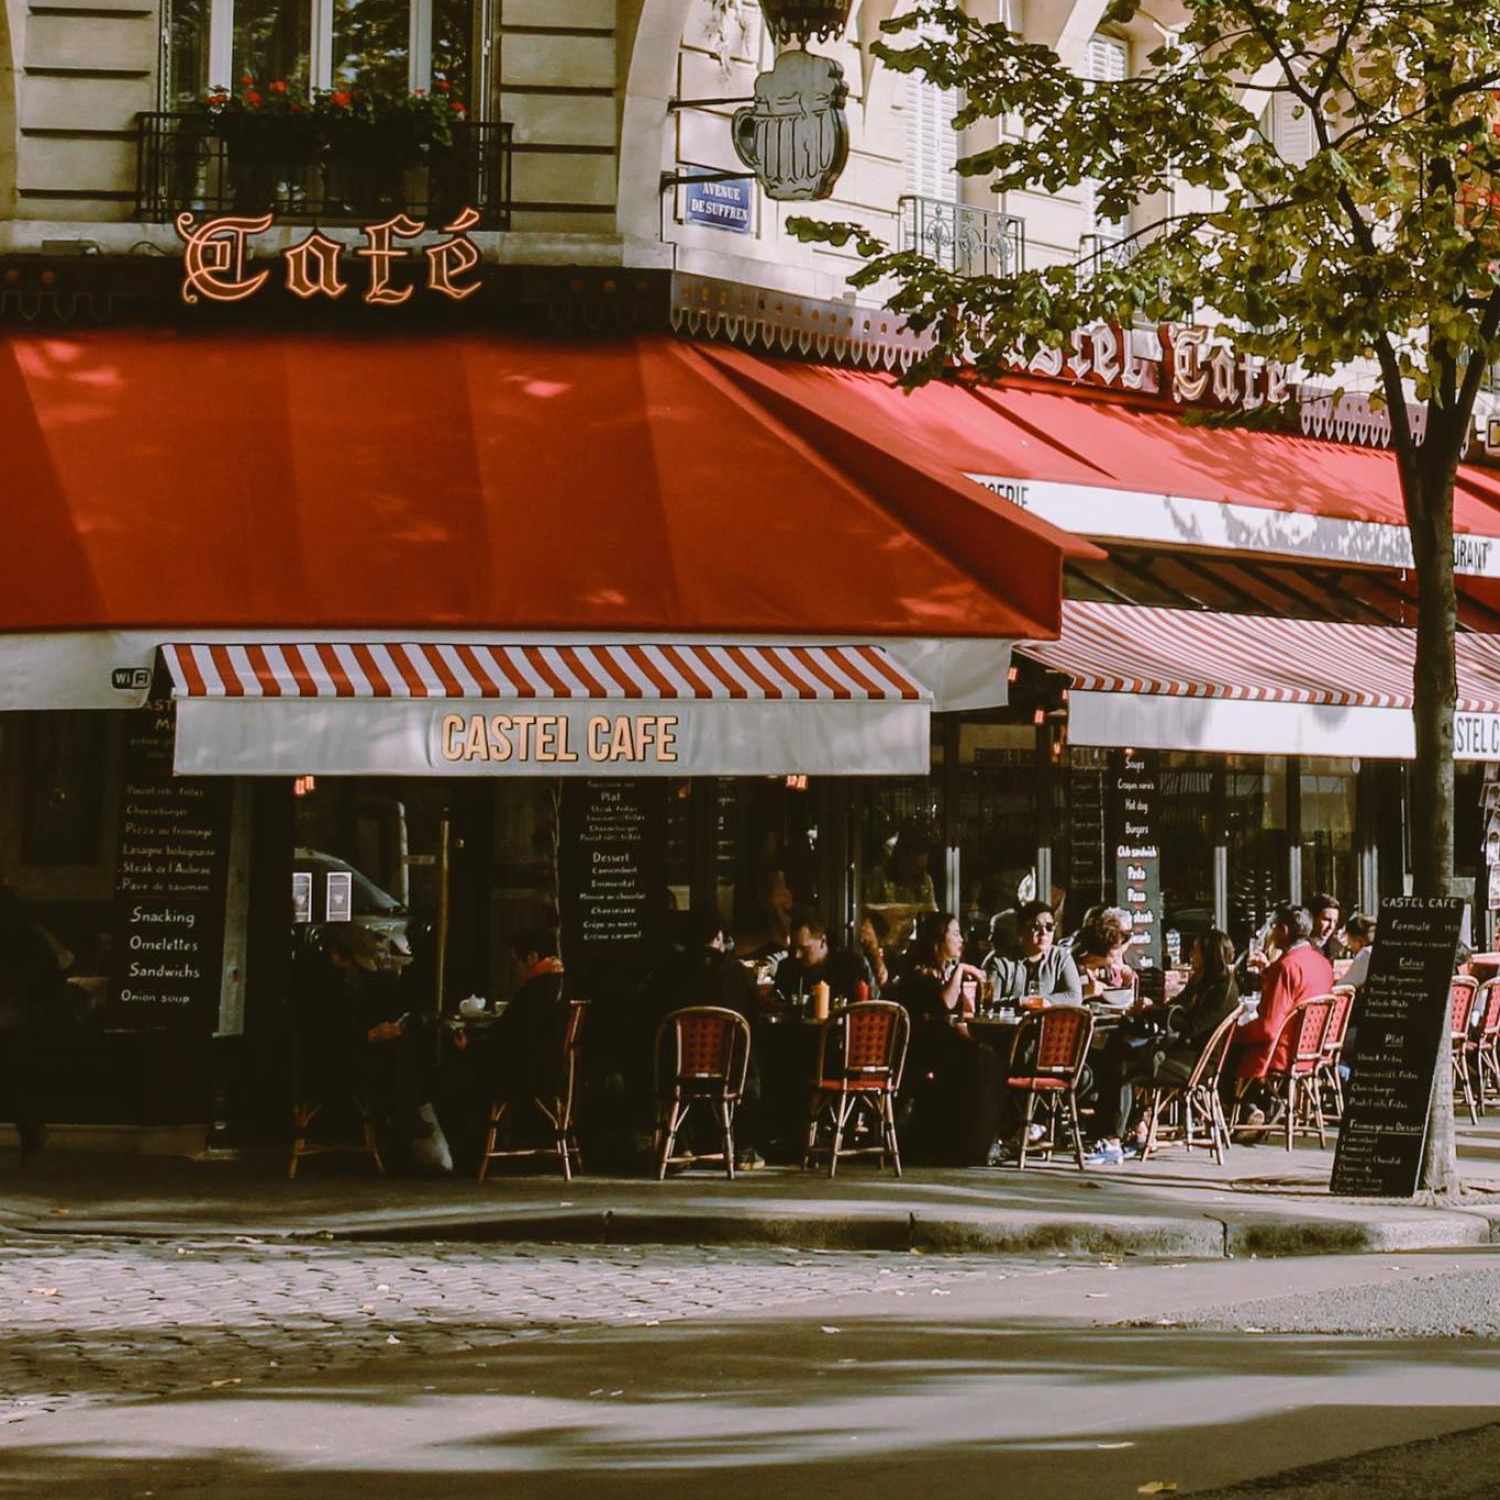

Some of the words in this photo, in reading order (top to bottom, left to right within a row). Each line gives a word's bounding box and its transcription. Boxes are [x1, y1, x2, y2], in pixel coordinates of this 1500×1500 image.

[703, 182, 741, 201] AVENUE
[691, 199, 705, 213] DE
[706, 201, 748, 221] SUFFREN
[176, 208, 482, 304] Café
[441, 714, 579, 762] CASTEL
[587, 714, 679, 762] CAFE
[1453, 718, 1487, 754] STEL
[1125, 756, 1145, 773] Soups
[1125, 821, 1149, 838] Burgers
[592, 852, 630, 863] Dessert
[123, 861, 152, 873] Steak
[1381, 897, 1424, 908] CASTEL
[1428, 898, 1457, 909] CAFE
[130, 906, 195, 929] Snacking
[1391, 919, 1431, 931] Formule
[129, 935, 198, 952] Omelettes
[129, 962, 200, 978] Sandwichs
[121, 989, 156, 1001] Onion
[161, 994, 190, 1004] soup
